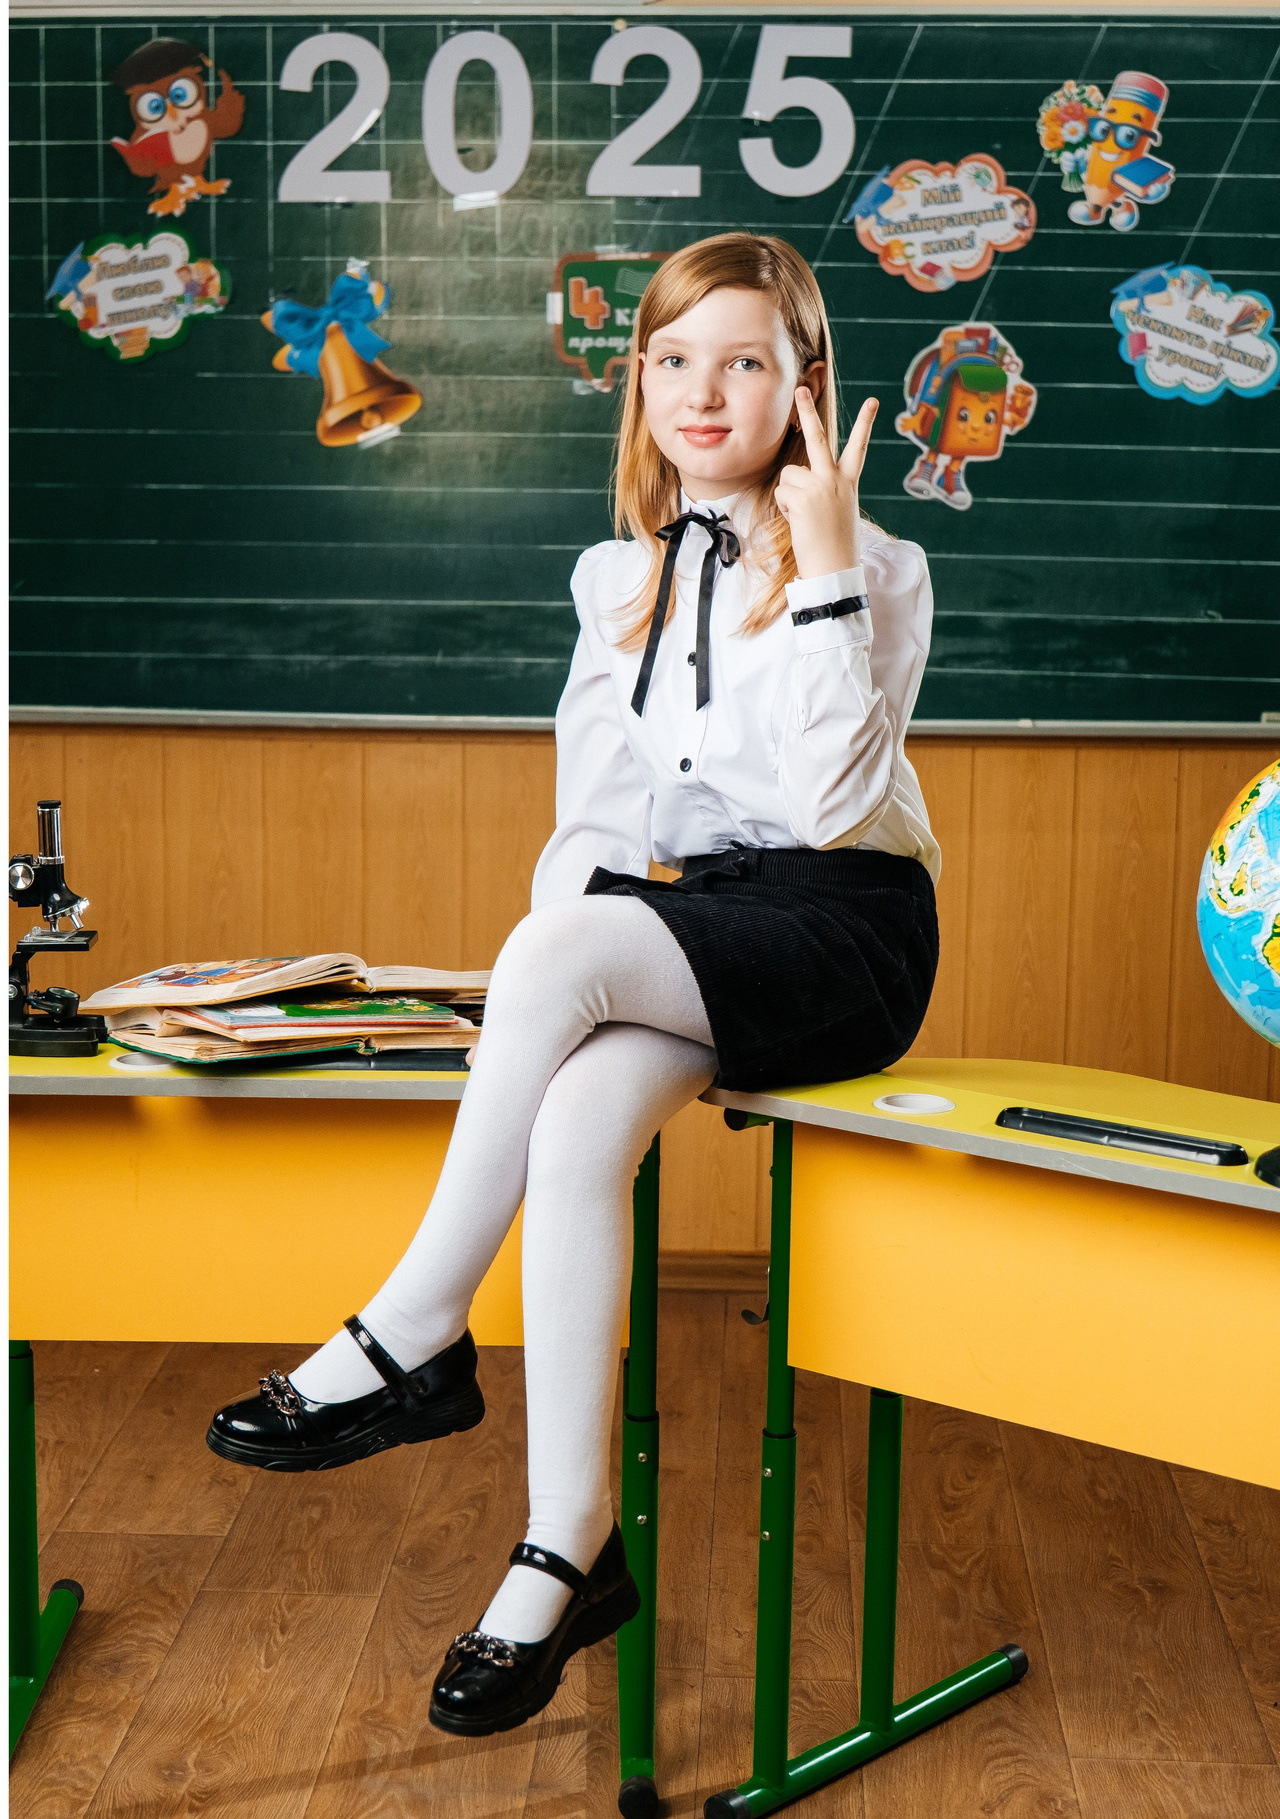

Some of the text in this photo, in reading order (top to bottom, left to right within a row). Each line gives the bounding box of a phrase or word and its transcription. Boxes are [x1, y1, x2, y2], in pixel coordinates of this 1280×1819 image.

[278, 24, 855, 203] 2025
[921, 184, 961, 206] Мій
[881, 201, 1007, 236] найкращий
[568, 276, 610, 330] 4
[1186, 304, 1223, 332] Нас
[1126, 310, 1271, 373] чекають цікаві
[1155, 345, 1224, 380] уроки!
